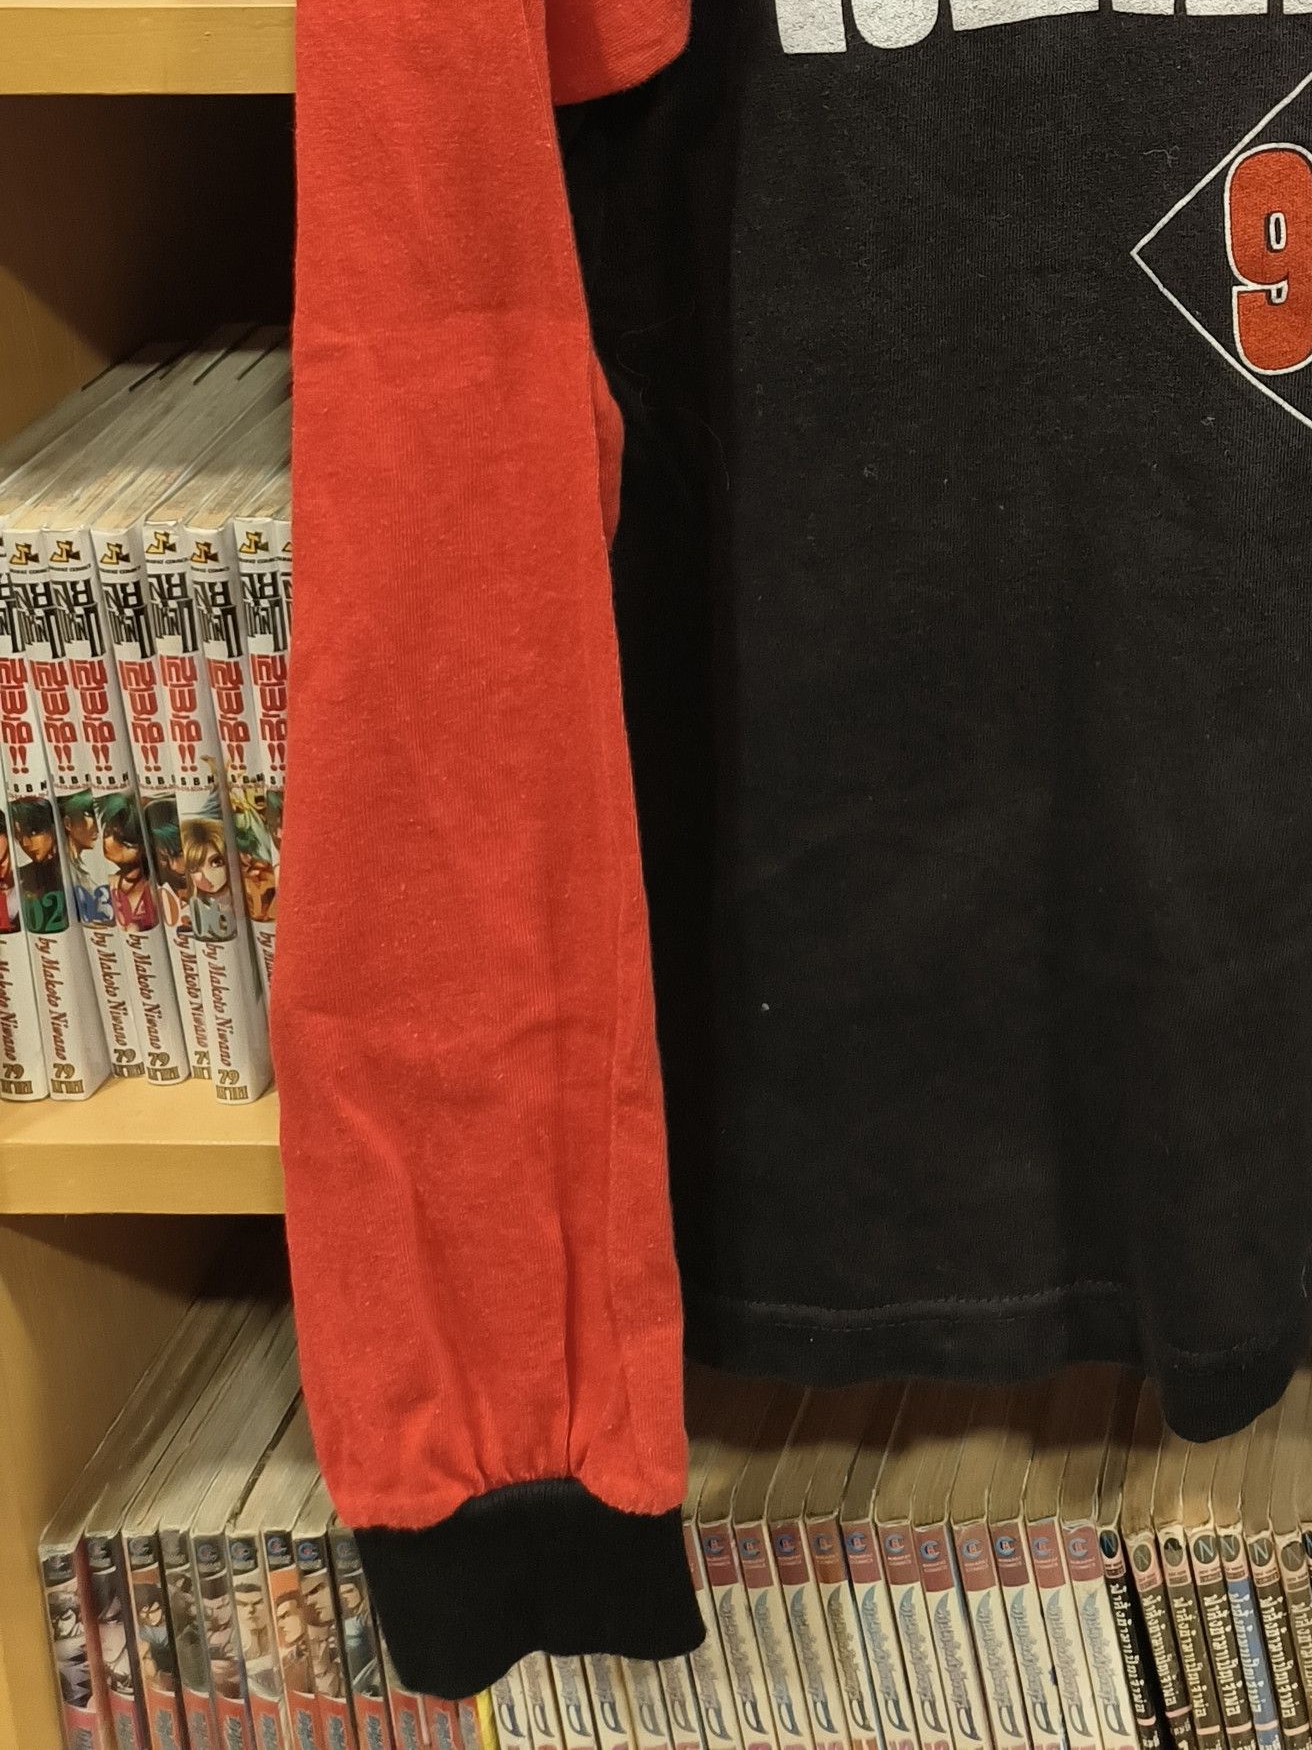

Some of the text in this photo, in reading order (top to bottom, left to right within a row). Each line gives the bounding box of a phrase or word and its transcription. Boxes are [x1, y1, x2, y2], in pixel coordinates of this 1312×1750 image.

[37, 937, 67, 1061] by Makoto Niwano
[93, 931, 127, 1047] by Makoto Niwano
[126, 934, 162, 1049] by Makoto Niwano
[177, 932, 209, 1049] by Makoto Niwano
[207, 944, 234, 1066] by Makoto Niwano
[53, 1064, 75, 1078] 79
[113, 1049, 136, 1062] 79
[148, 1052, 170, 1066] 79
[218, 1070, 240, 1084] 79
